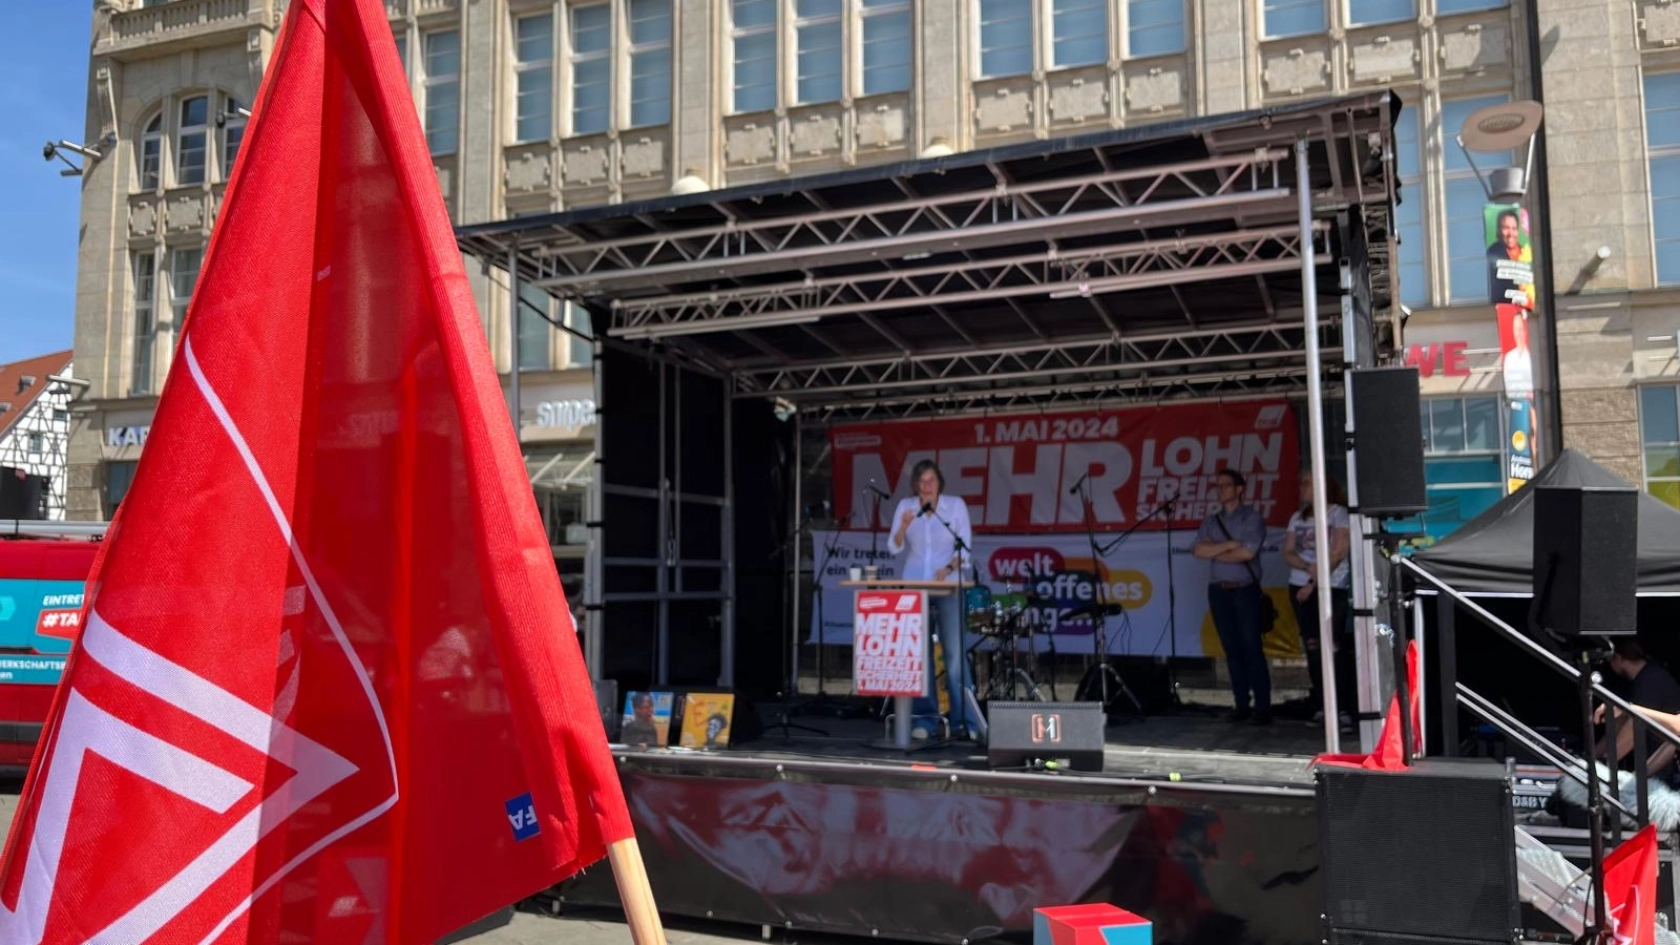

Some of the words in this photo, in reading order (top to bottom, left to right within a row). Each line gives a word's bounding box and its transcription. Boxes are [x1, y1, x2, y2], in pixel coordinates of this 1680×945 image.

[537, 399, 597, 431] snipe
[975, 422, 992, 443] 1.
[996, 419, 1049, 442] MAI
[1052, 416, 1120, 441] 2024
[1140, 432, 1283, 477] LOHN
[850, 440, 1133, 529] MEHR
[994, 552, 1054, 578] welt
[1036, 574, 1144, 601] offenes
[42, 612, 82, 628] #TA
[855, 613, 923, 635] MEHR
[855, 634, 923, 657] LOHN
